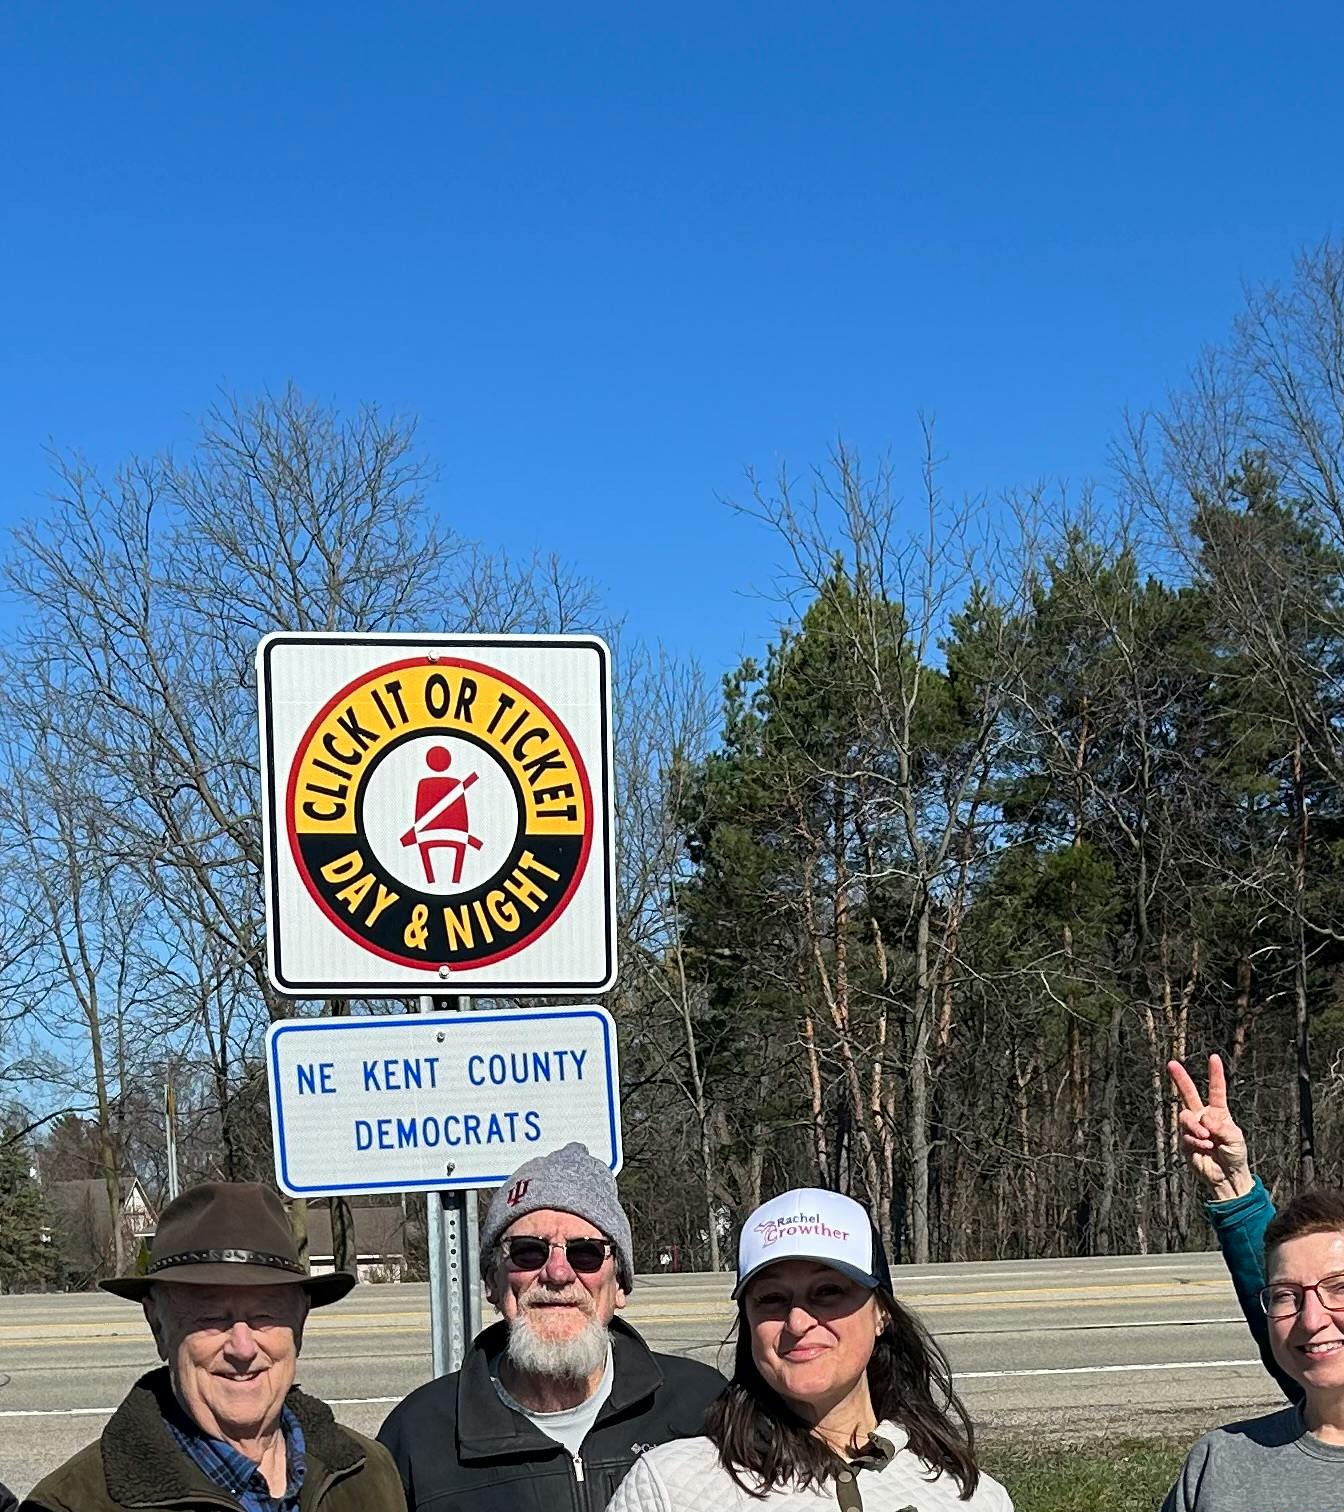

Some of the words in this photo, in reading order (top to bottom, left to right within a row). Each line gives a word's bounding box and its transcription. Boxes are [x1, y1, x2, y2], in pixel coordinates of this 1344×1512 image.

[303, 706, 380, 821] CLICK
[371, 681, 409, 730] IT
[425, 674, 476, 722] OR
[488, 692, 577, 822] TICKET
[320, 851, 401, 928] DAY
[404, 904, 428, 951] &
[444, 851, 561, 950] NIGHT
[295, 1061, 336, 1096] NE
[361, 1056, 439, 1092] KENT
[466, 1049, 588, 1087] COUNTY
[353, 1110, 542, 1152] DEMOCRATS
[767, 1222, 850, 1242] Crowther
[777, 1212, 820, 1227] Rachel
